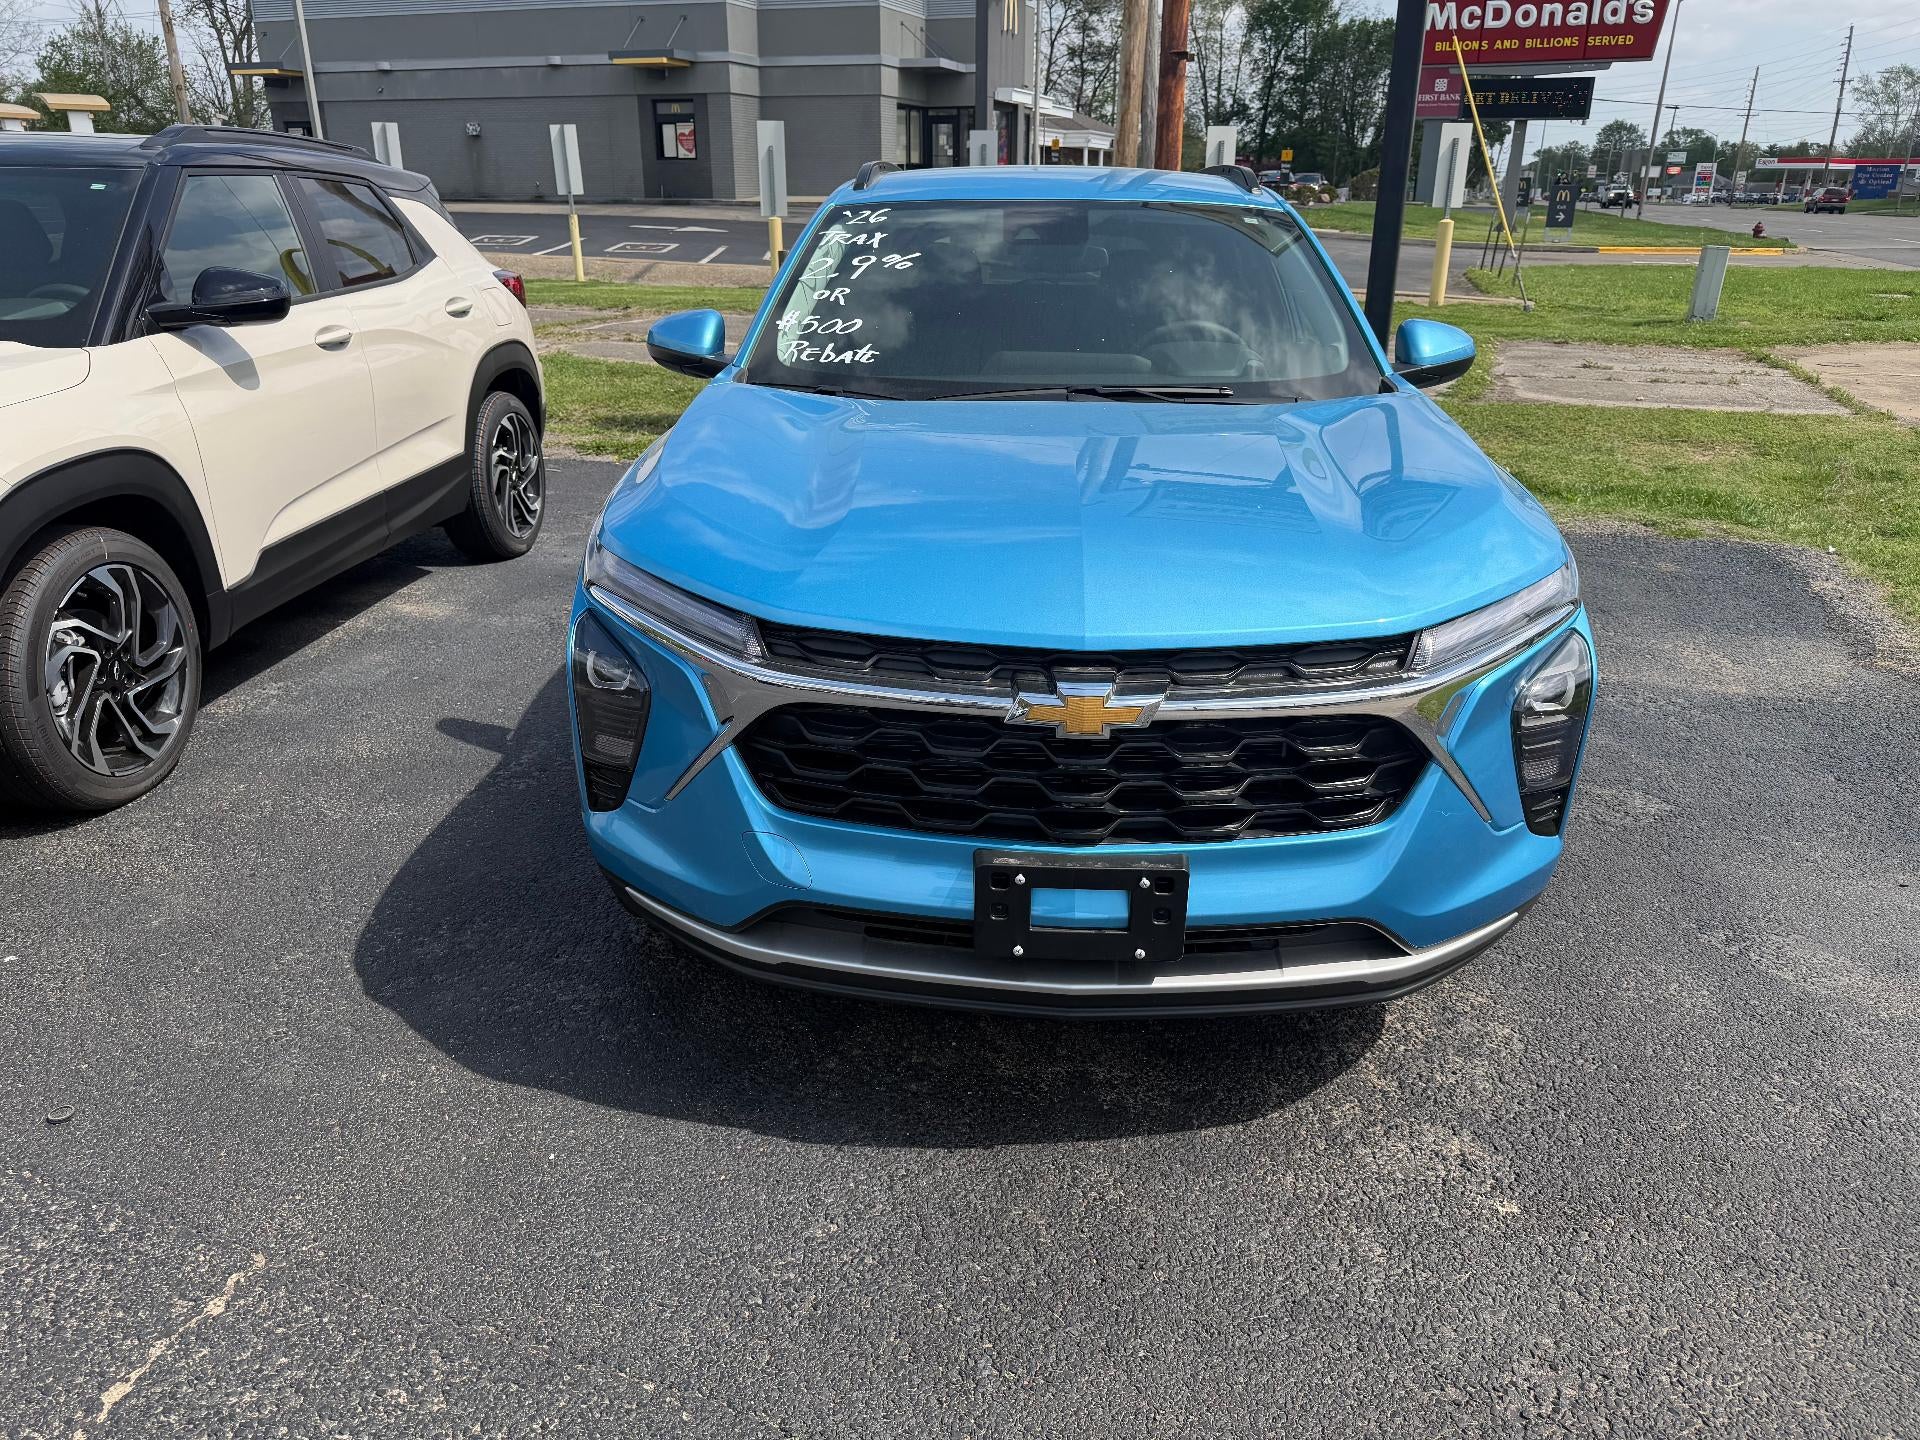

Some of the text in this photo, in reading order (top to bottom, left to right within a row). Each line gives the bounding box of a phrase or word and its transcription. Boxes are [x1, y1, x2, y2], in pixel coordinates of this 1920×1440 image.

[1425, 0, 1655, 31] McDonald's
[1435, 35, 1634, 52] BILLIONS AND BILLIONS SERVED
[1418, 93, 1461, 101] FIRST BANK
[818, 231, 889, 249] TRAX
